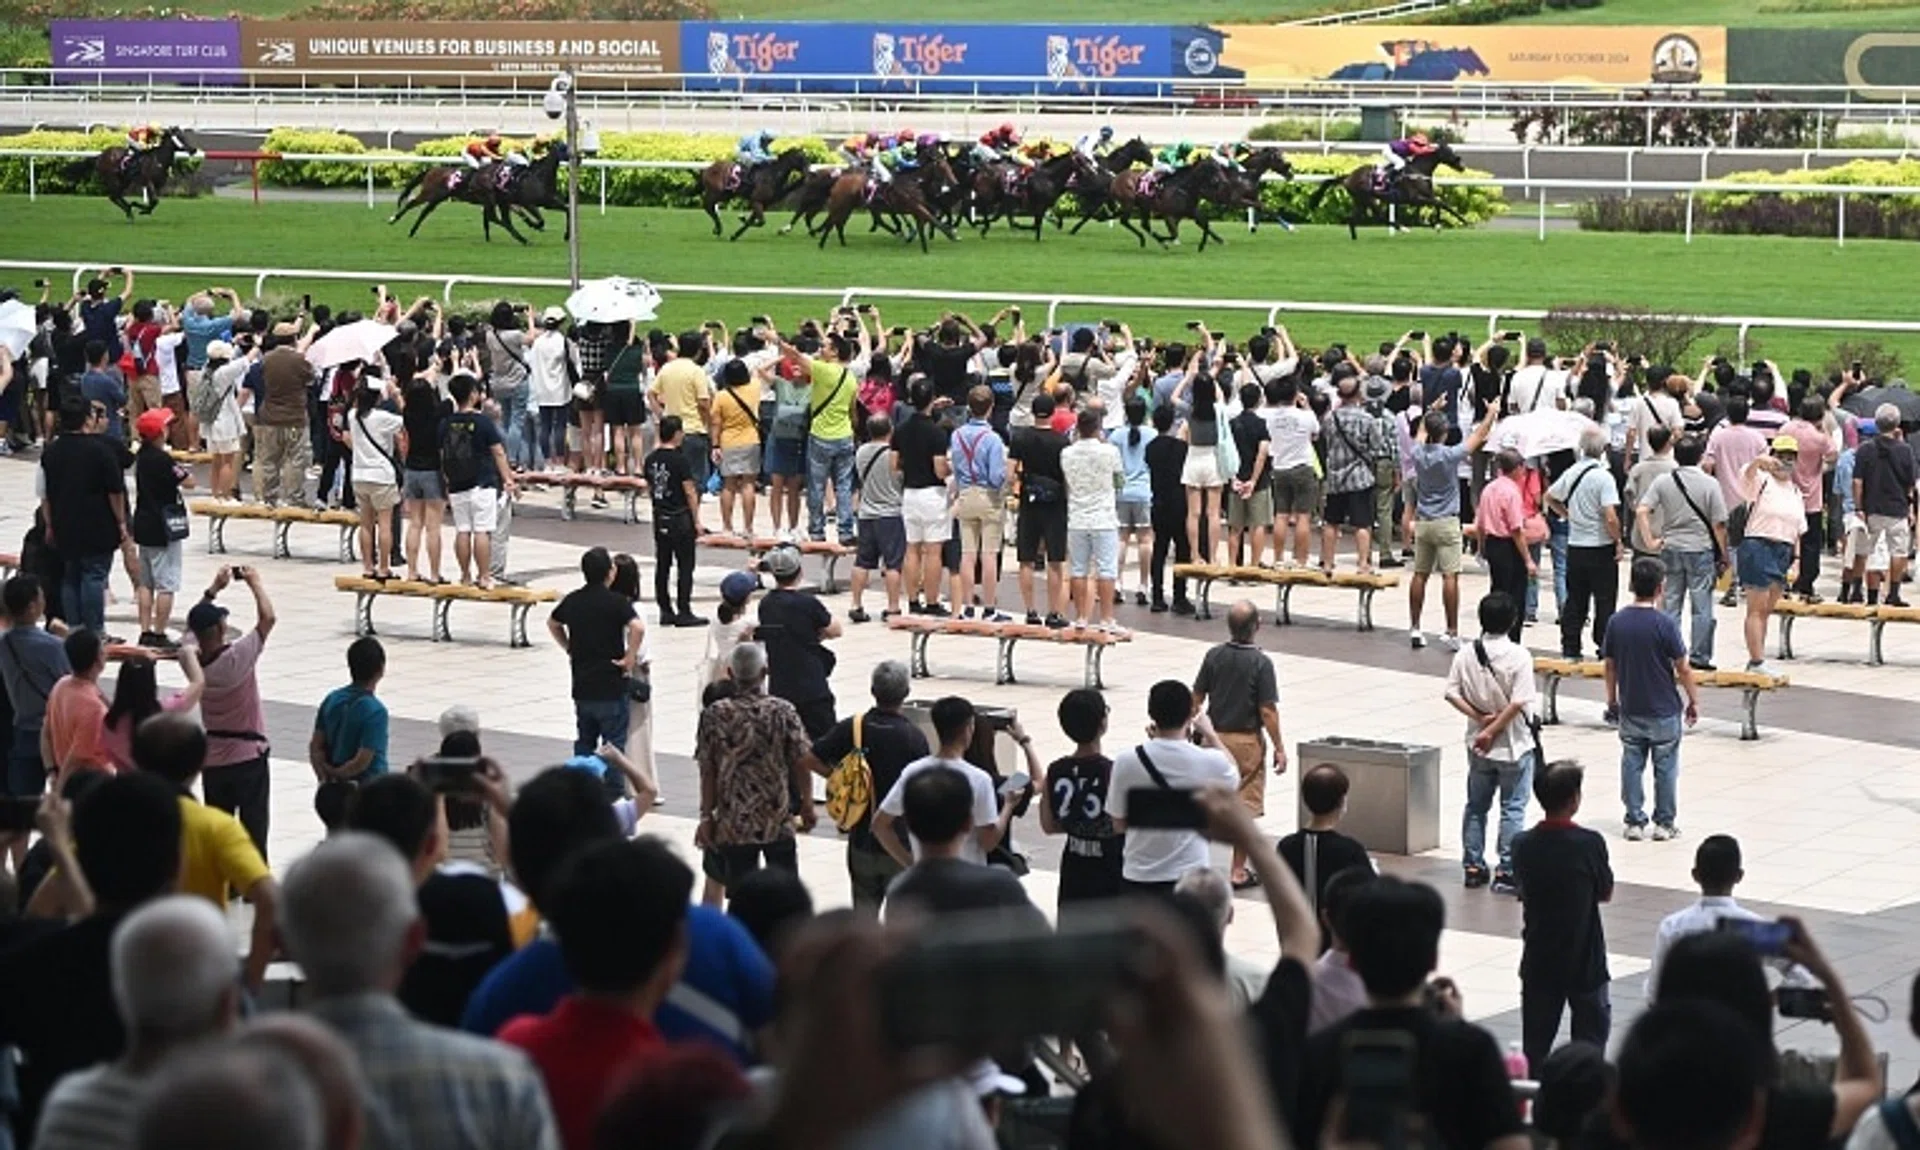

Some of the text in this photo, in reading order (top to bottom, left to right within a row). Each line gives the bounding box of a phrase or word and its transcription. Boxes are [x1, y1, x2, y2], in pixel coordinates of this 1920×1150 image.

[115, 44, 228, 57] SINGAPORE TURF CLUB
[308, 37, 662, 56] UNIQUE VENUES FOR BUSINESS AND SOCIAL
[732, 32, 800, 72] Tiger
[898, 33, 968, 75] Tiger
[1073, 35, 1146, 77] Tiger
